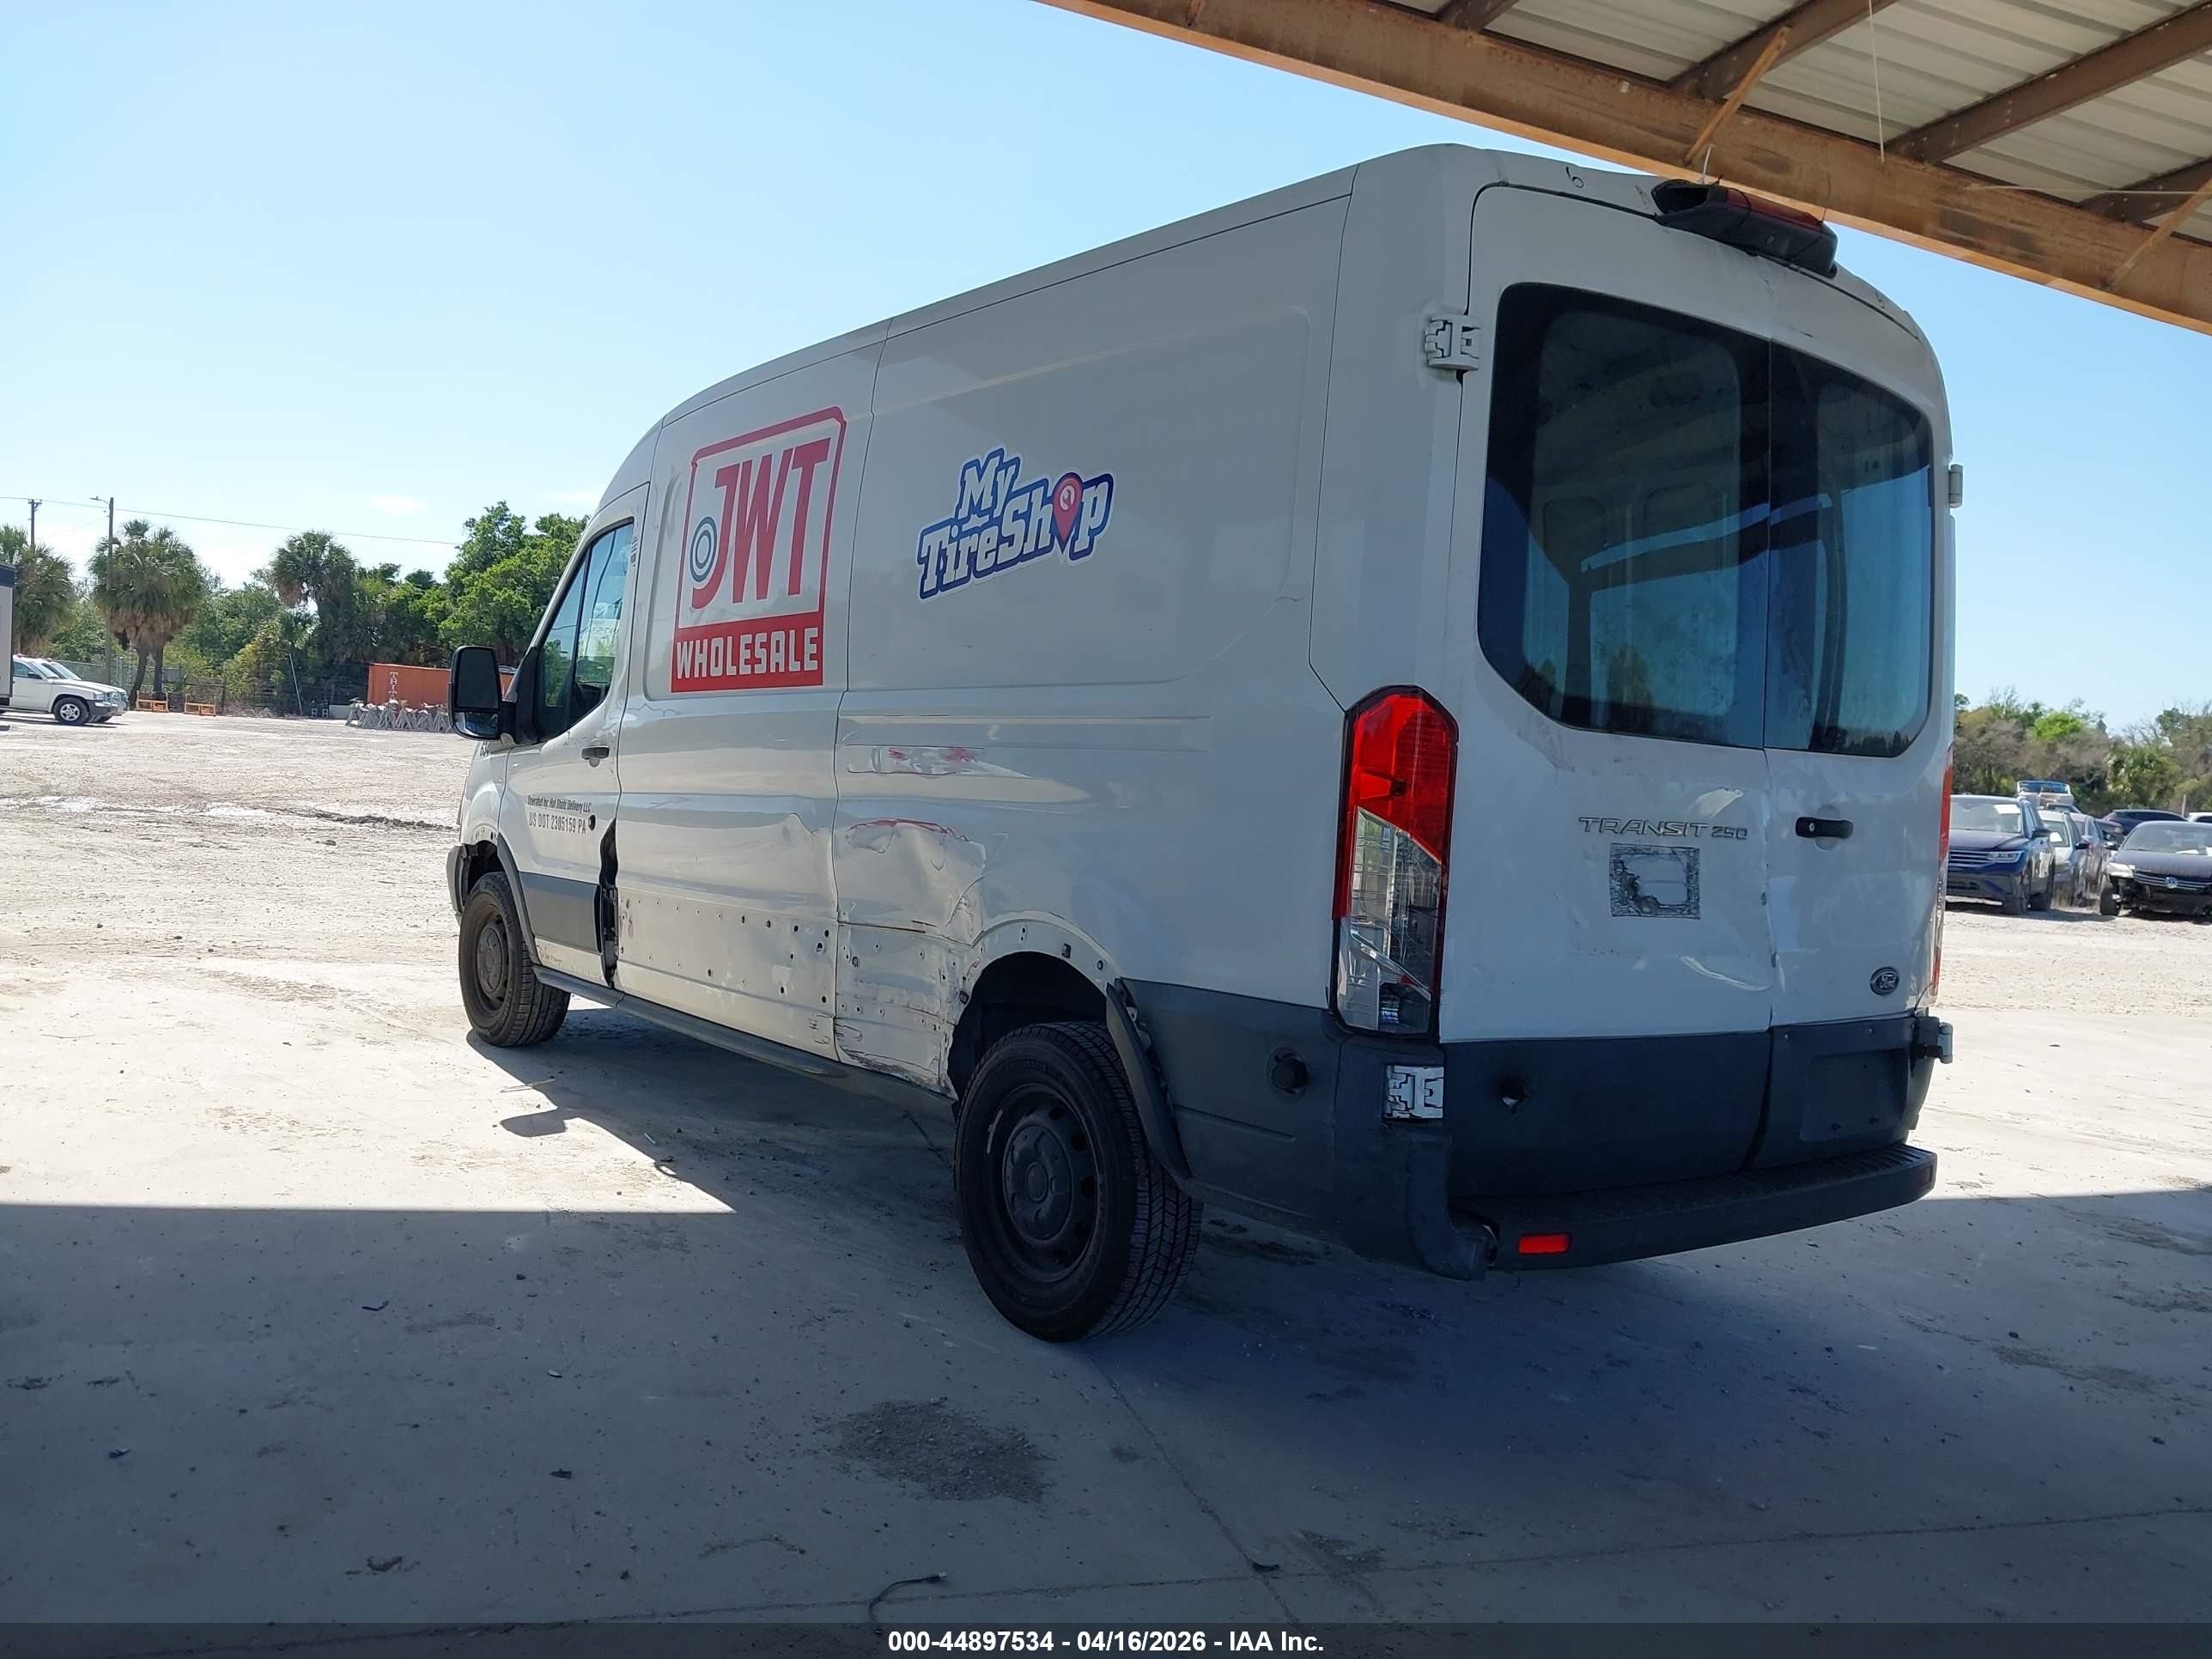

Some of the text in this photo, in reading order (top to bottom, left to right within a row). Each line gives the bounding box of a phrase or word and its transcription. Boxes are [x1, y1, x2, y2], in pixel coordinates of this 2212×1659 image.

[955, 448, 1021, 520] My
[690, 437, 831, 610] JWT
[677, 627, 818, 679] WHOLESALE
[529, 811, 537, 827] US
[538, 813, 550, 829] DOT
[578, 818, 586, 835] PA
[1578, 817, 1748, 840] TRANSIT 250
